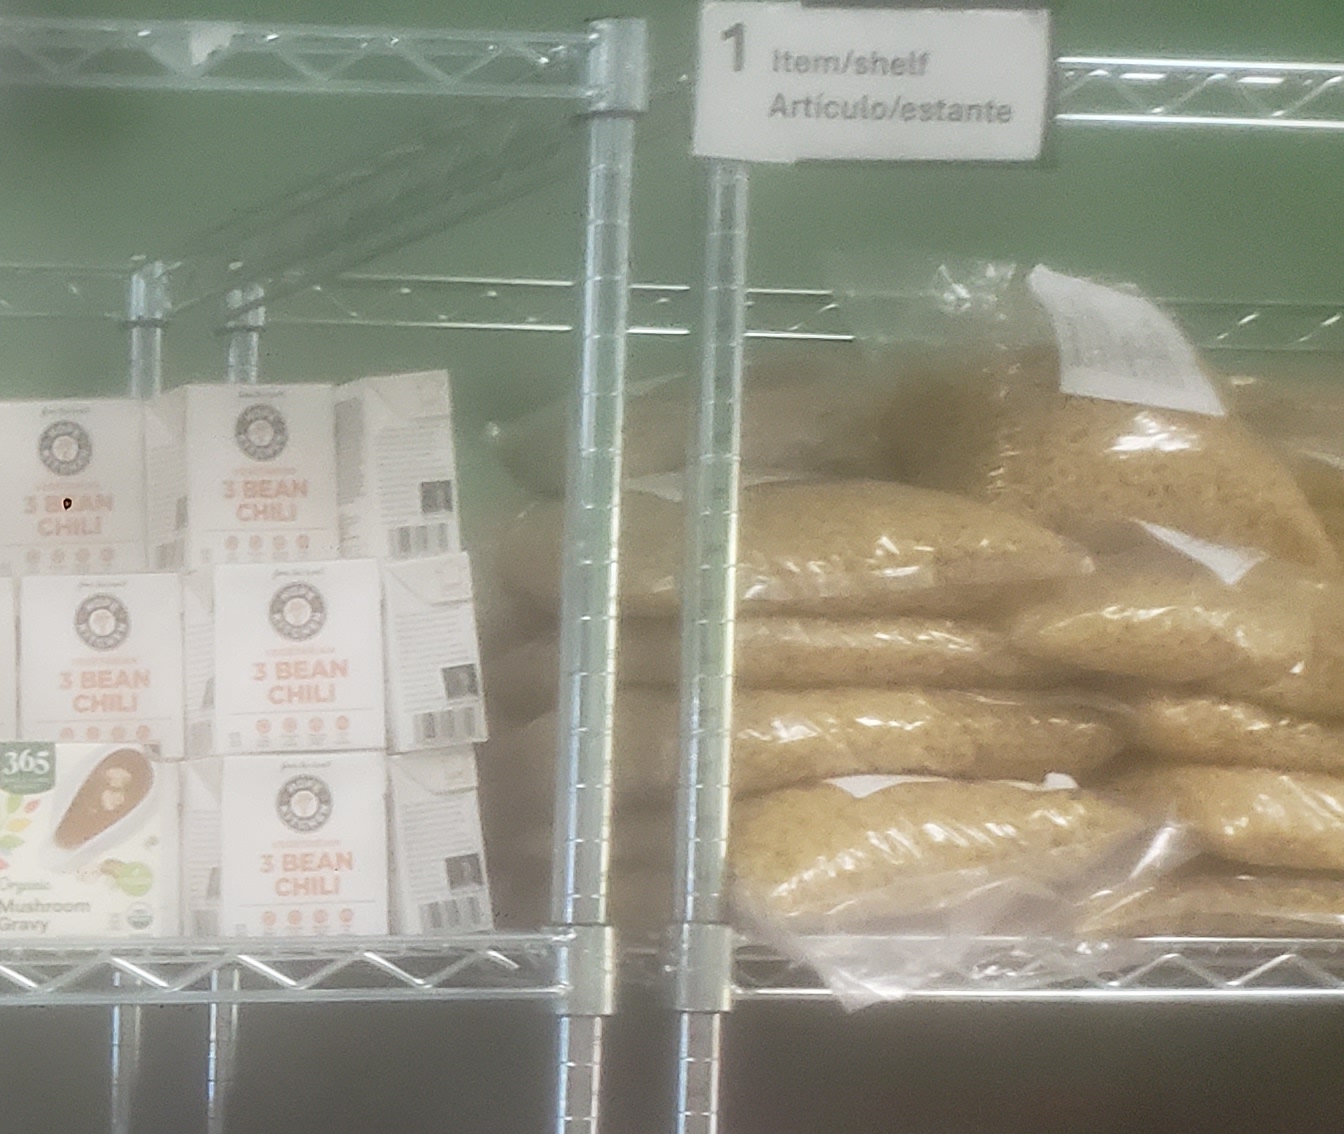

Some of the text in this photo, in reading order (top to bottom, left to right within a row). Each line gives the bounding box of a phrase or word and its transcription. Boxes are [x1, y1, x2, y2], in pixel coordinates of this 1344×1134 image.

[720, 22, 747, 72] 1
[771, 48, 929, 77] Item/shelf
[767, 93, 1013, 125] Artículo/estante
[241, 480, 308, 498] BEAN
[236, 503, 298, 521] CHILI
[274, 658, 348, 680] BEAN
[80, 670, 151, 689] BEAN
[72, 694, 138, 713] CHILI
[268, 684, 336, 705] CHILI
[4, 750, 49, 774] 365
[282, 851, 353, 871] BEAN
[275, 876, 339, 896] CHILI
